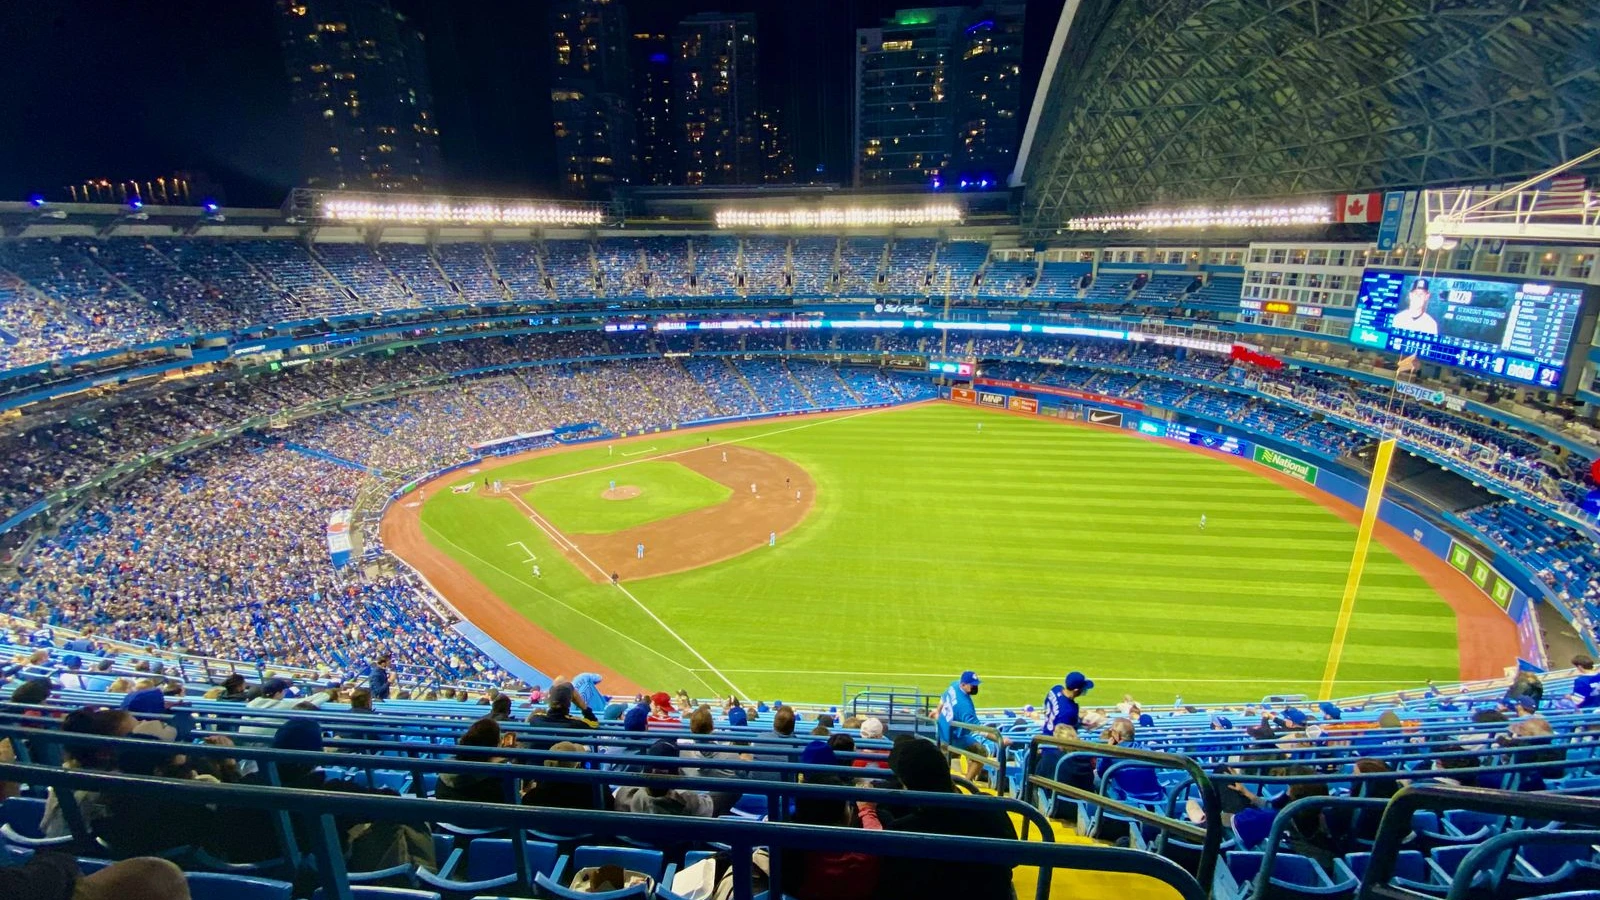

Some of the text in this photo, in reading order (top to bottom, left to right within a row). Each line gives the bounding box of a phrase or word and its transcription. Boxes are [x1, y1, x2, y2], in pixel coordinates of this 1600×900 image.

[1541, 368, 1556, 382] 91
[982, 394, 1003, 404] MNP
[1397, 382, 1434, 400] WESTJET
[1272, 453, 1309, 475] National
